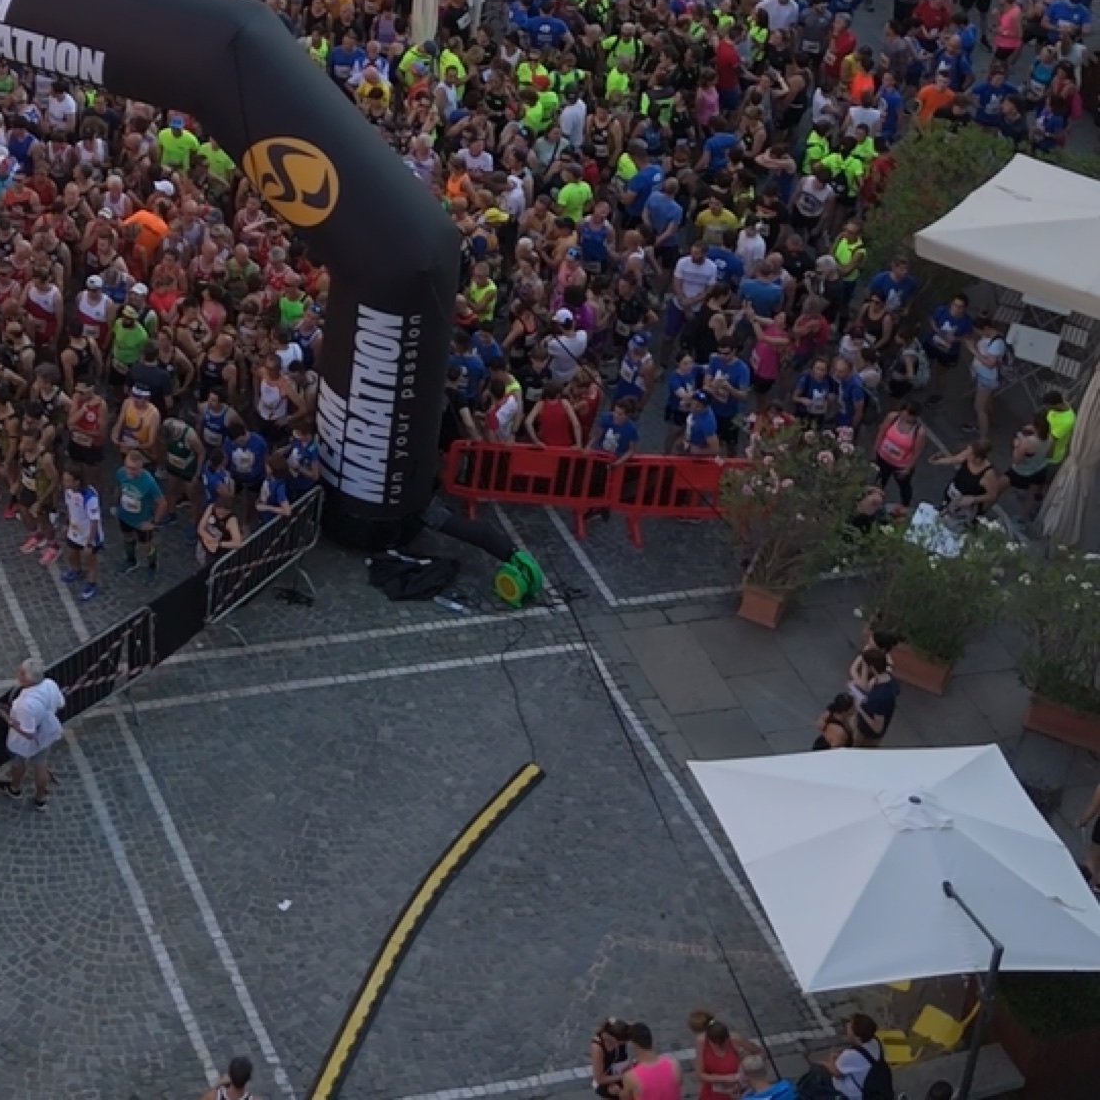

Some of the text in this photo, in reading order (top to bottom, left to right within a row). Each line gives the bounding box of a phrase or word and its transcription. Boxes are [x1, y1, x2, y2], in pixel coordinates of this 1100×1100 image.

[340, 303, 404, 504] MARATHON
[389, 315, 422, 505] run your passion
